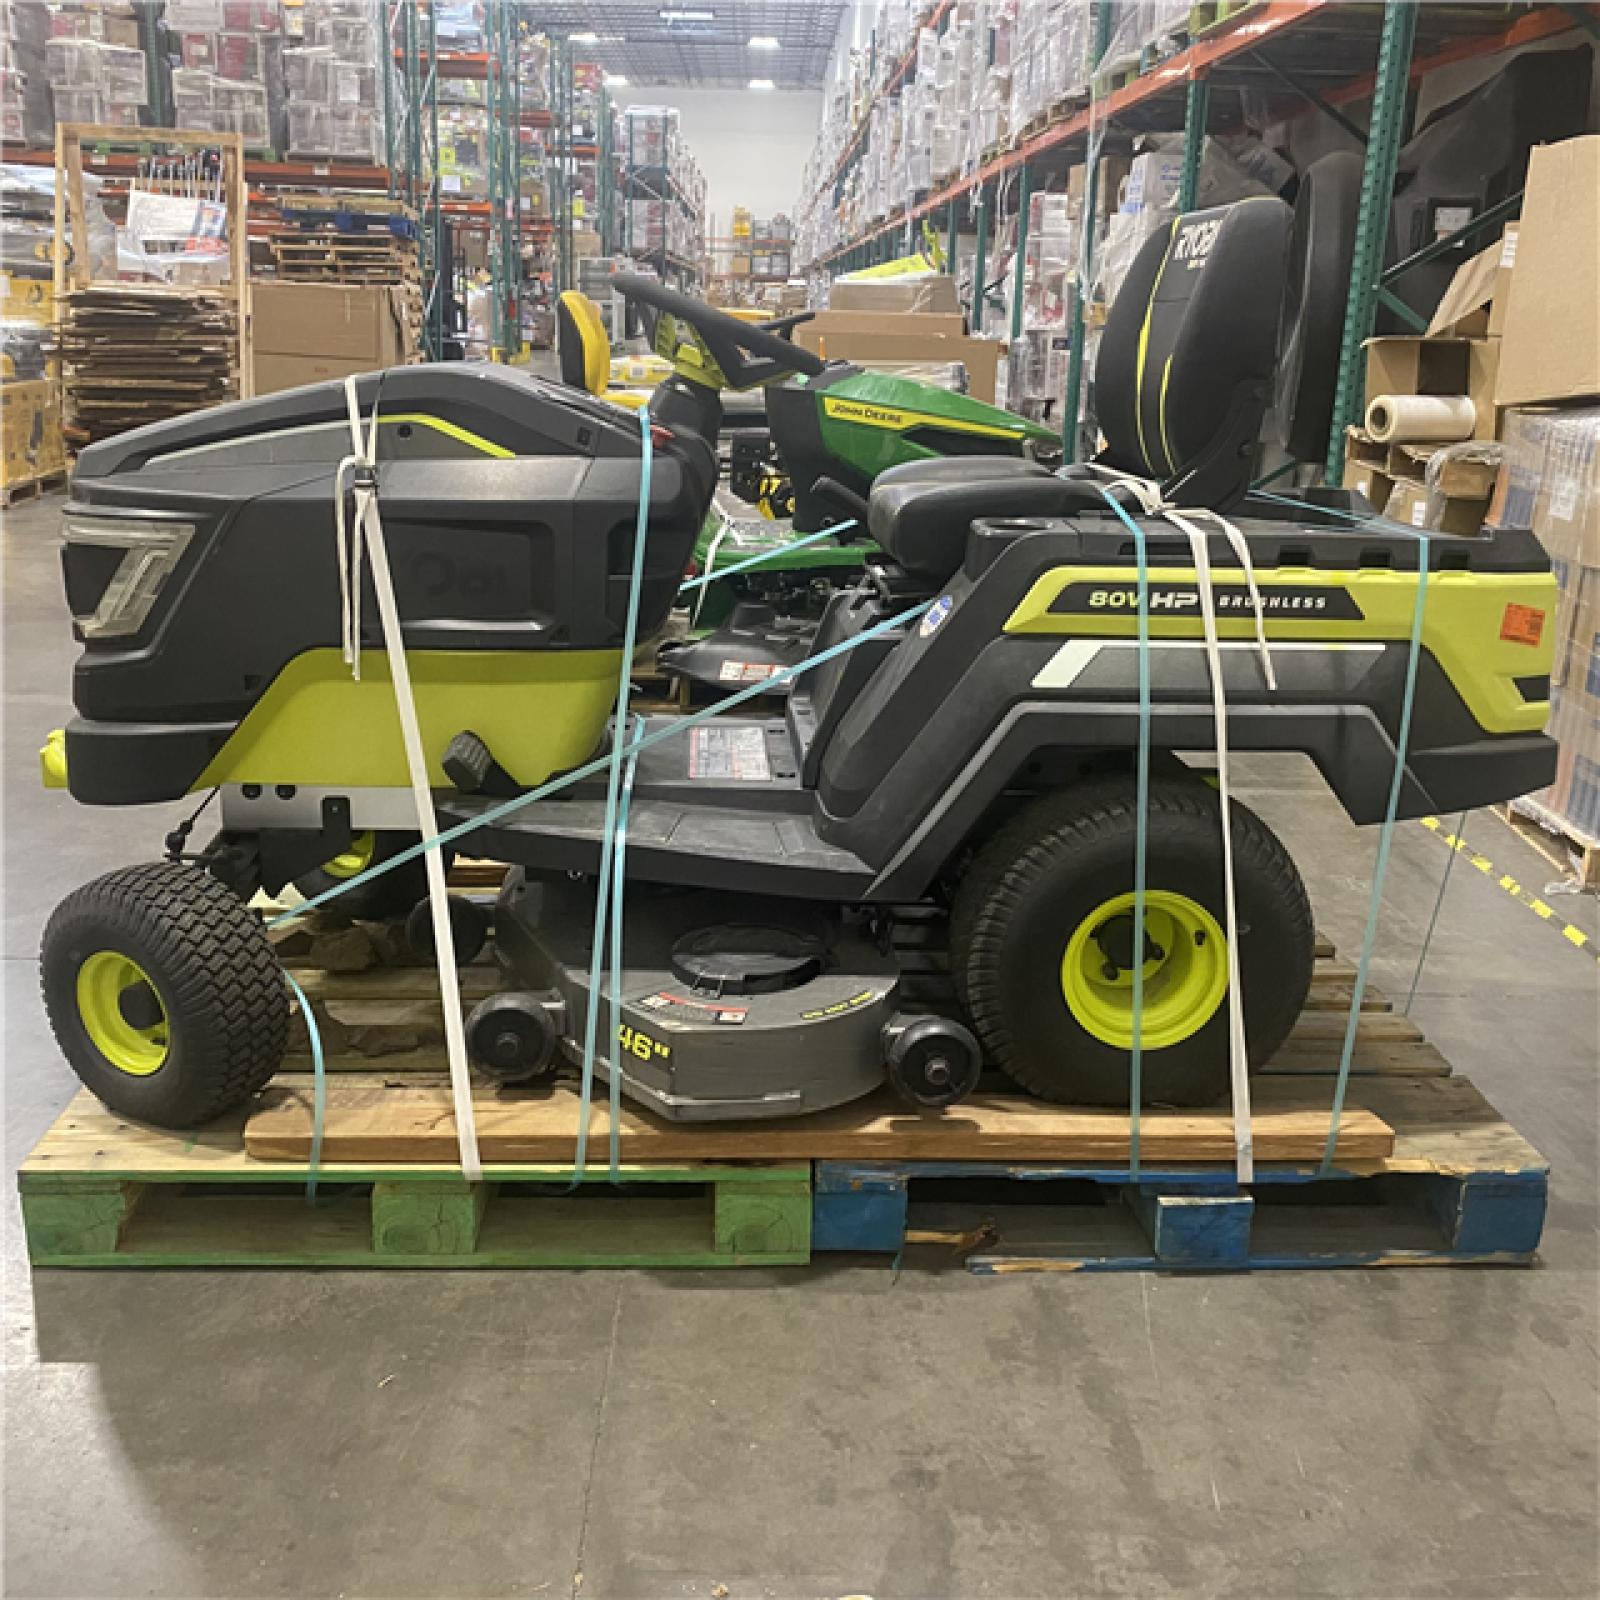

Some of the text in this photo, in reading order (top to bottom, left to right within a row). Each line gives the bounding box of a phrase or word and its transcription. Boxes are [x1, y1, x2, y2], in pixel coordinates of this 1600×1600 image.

[1174, 219, 1223, 260] RYOB
[832, 402, 902, 424] JOHN DEERE
[1150, 592, 1198, 608] HP
